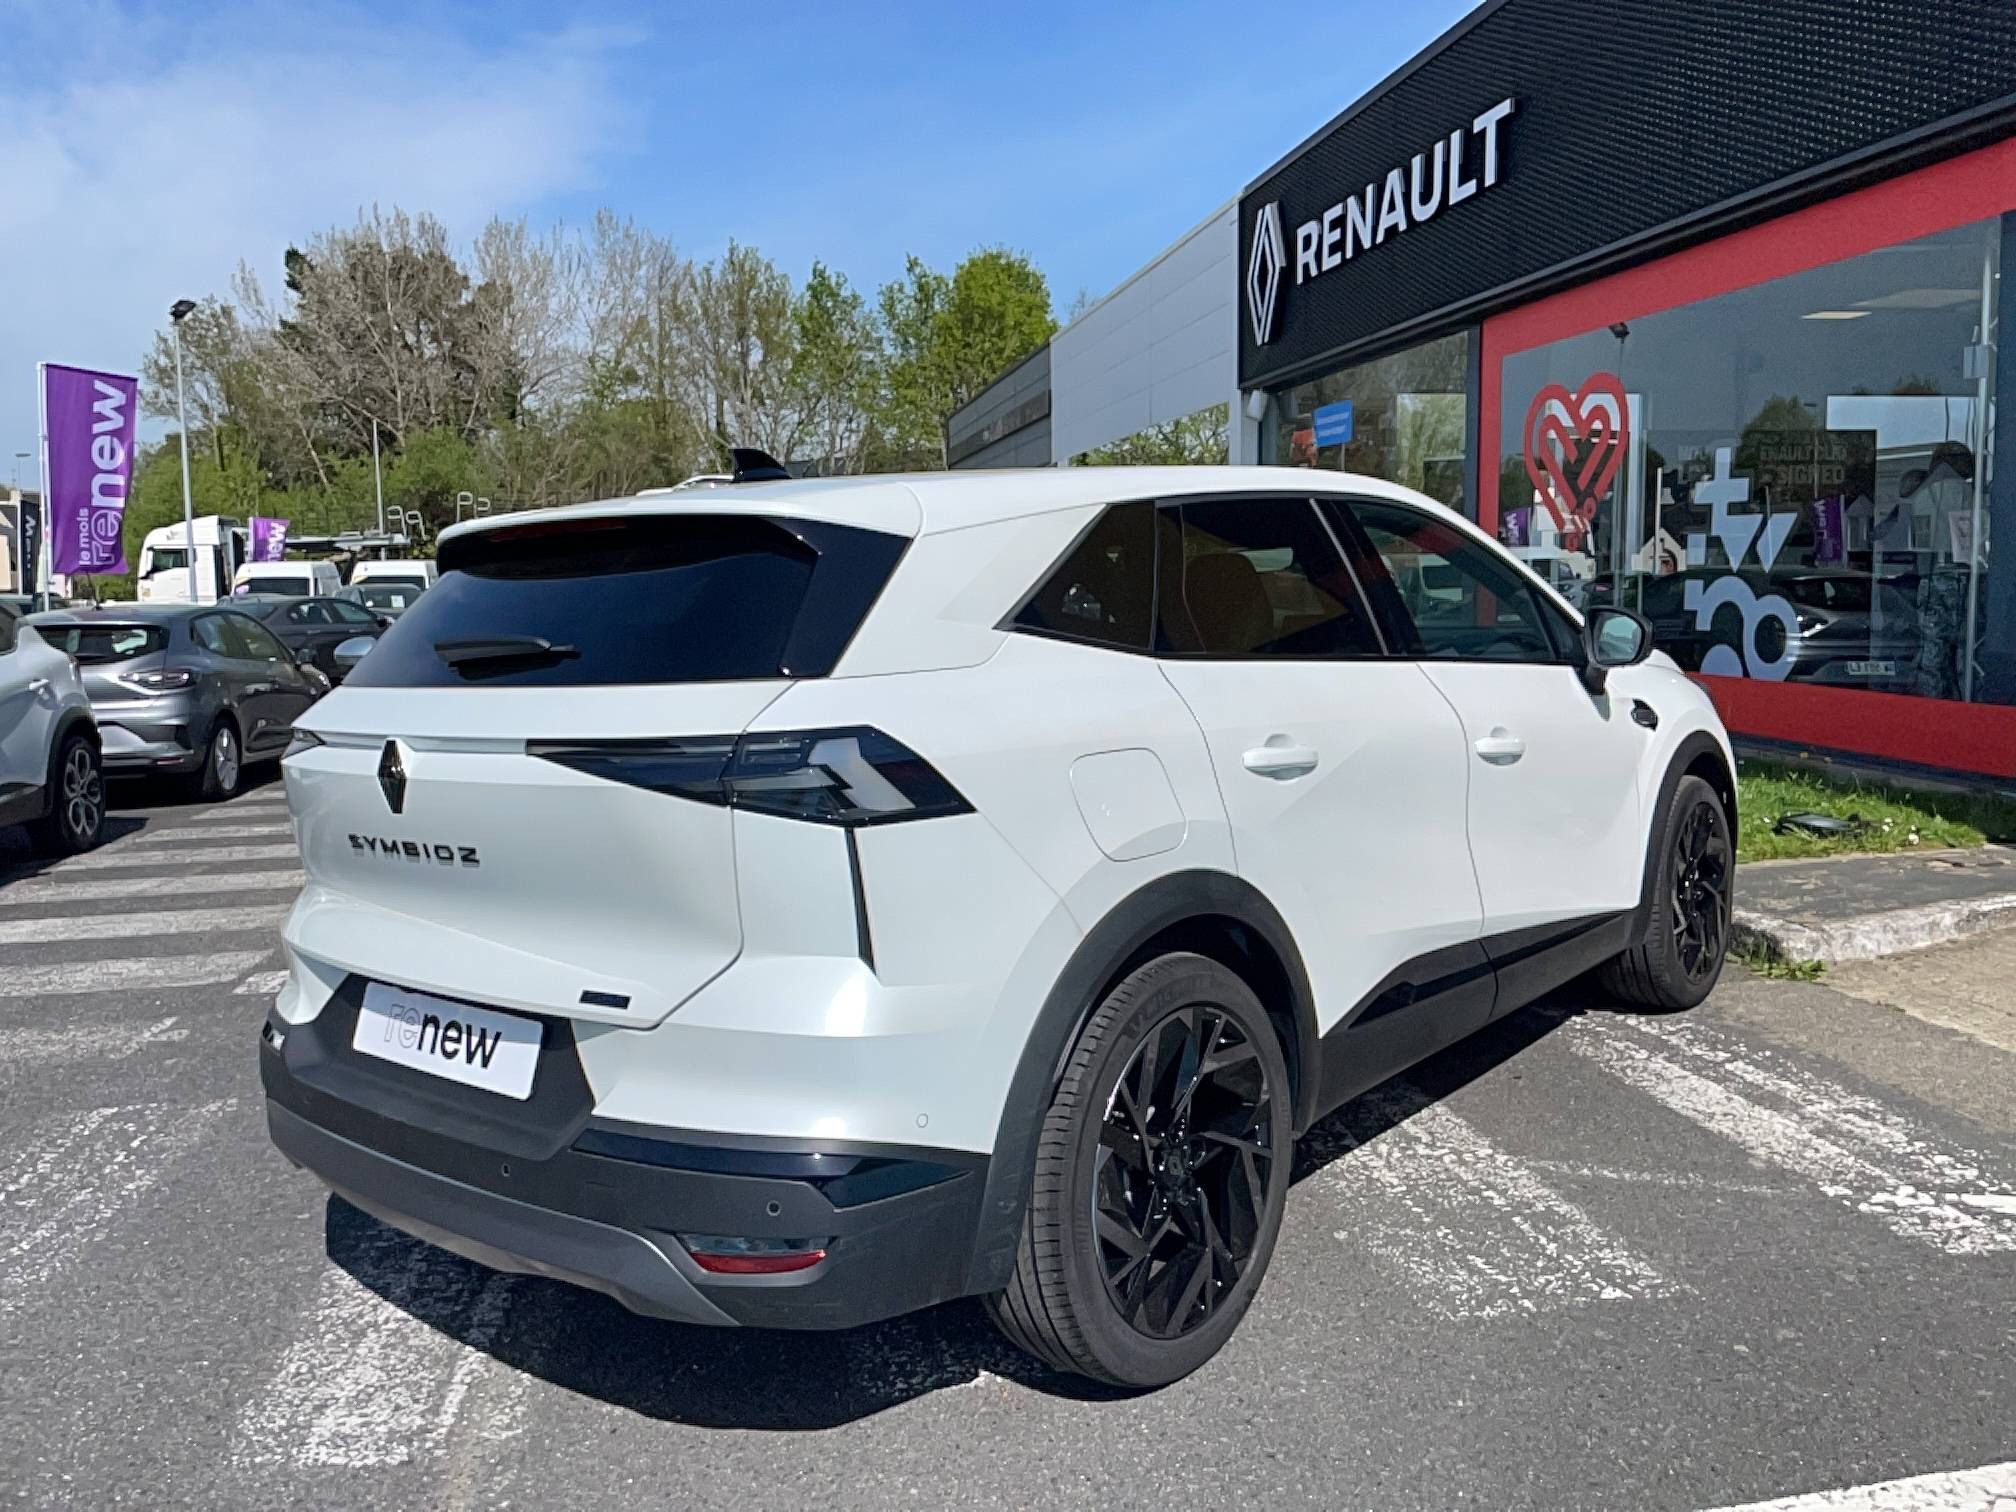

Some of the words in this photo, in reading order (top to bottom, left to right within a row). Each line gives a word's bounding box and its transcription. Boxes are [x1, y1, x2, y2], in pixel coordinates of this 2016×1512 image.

[1296, 97, 1515, 286] RENAULT
[91, 379, 127, 566] renew
[76, 506, 90, 547] mois
[78, 549, 91, 566] le
[348, 833, 480, 864] SYMBIOZ
[384, 1003, 502, 1070] renew
